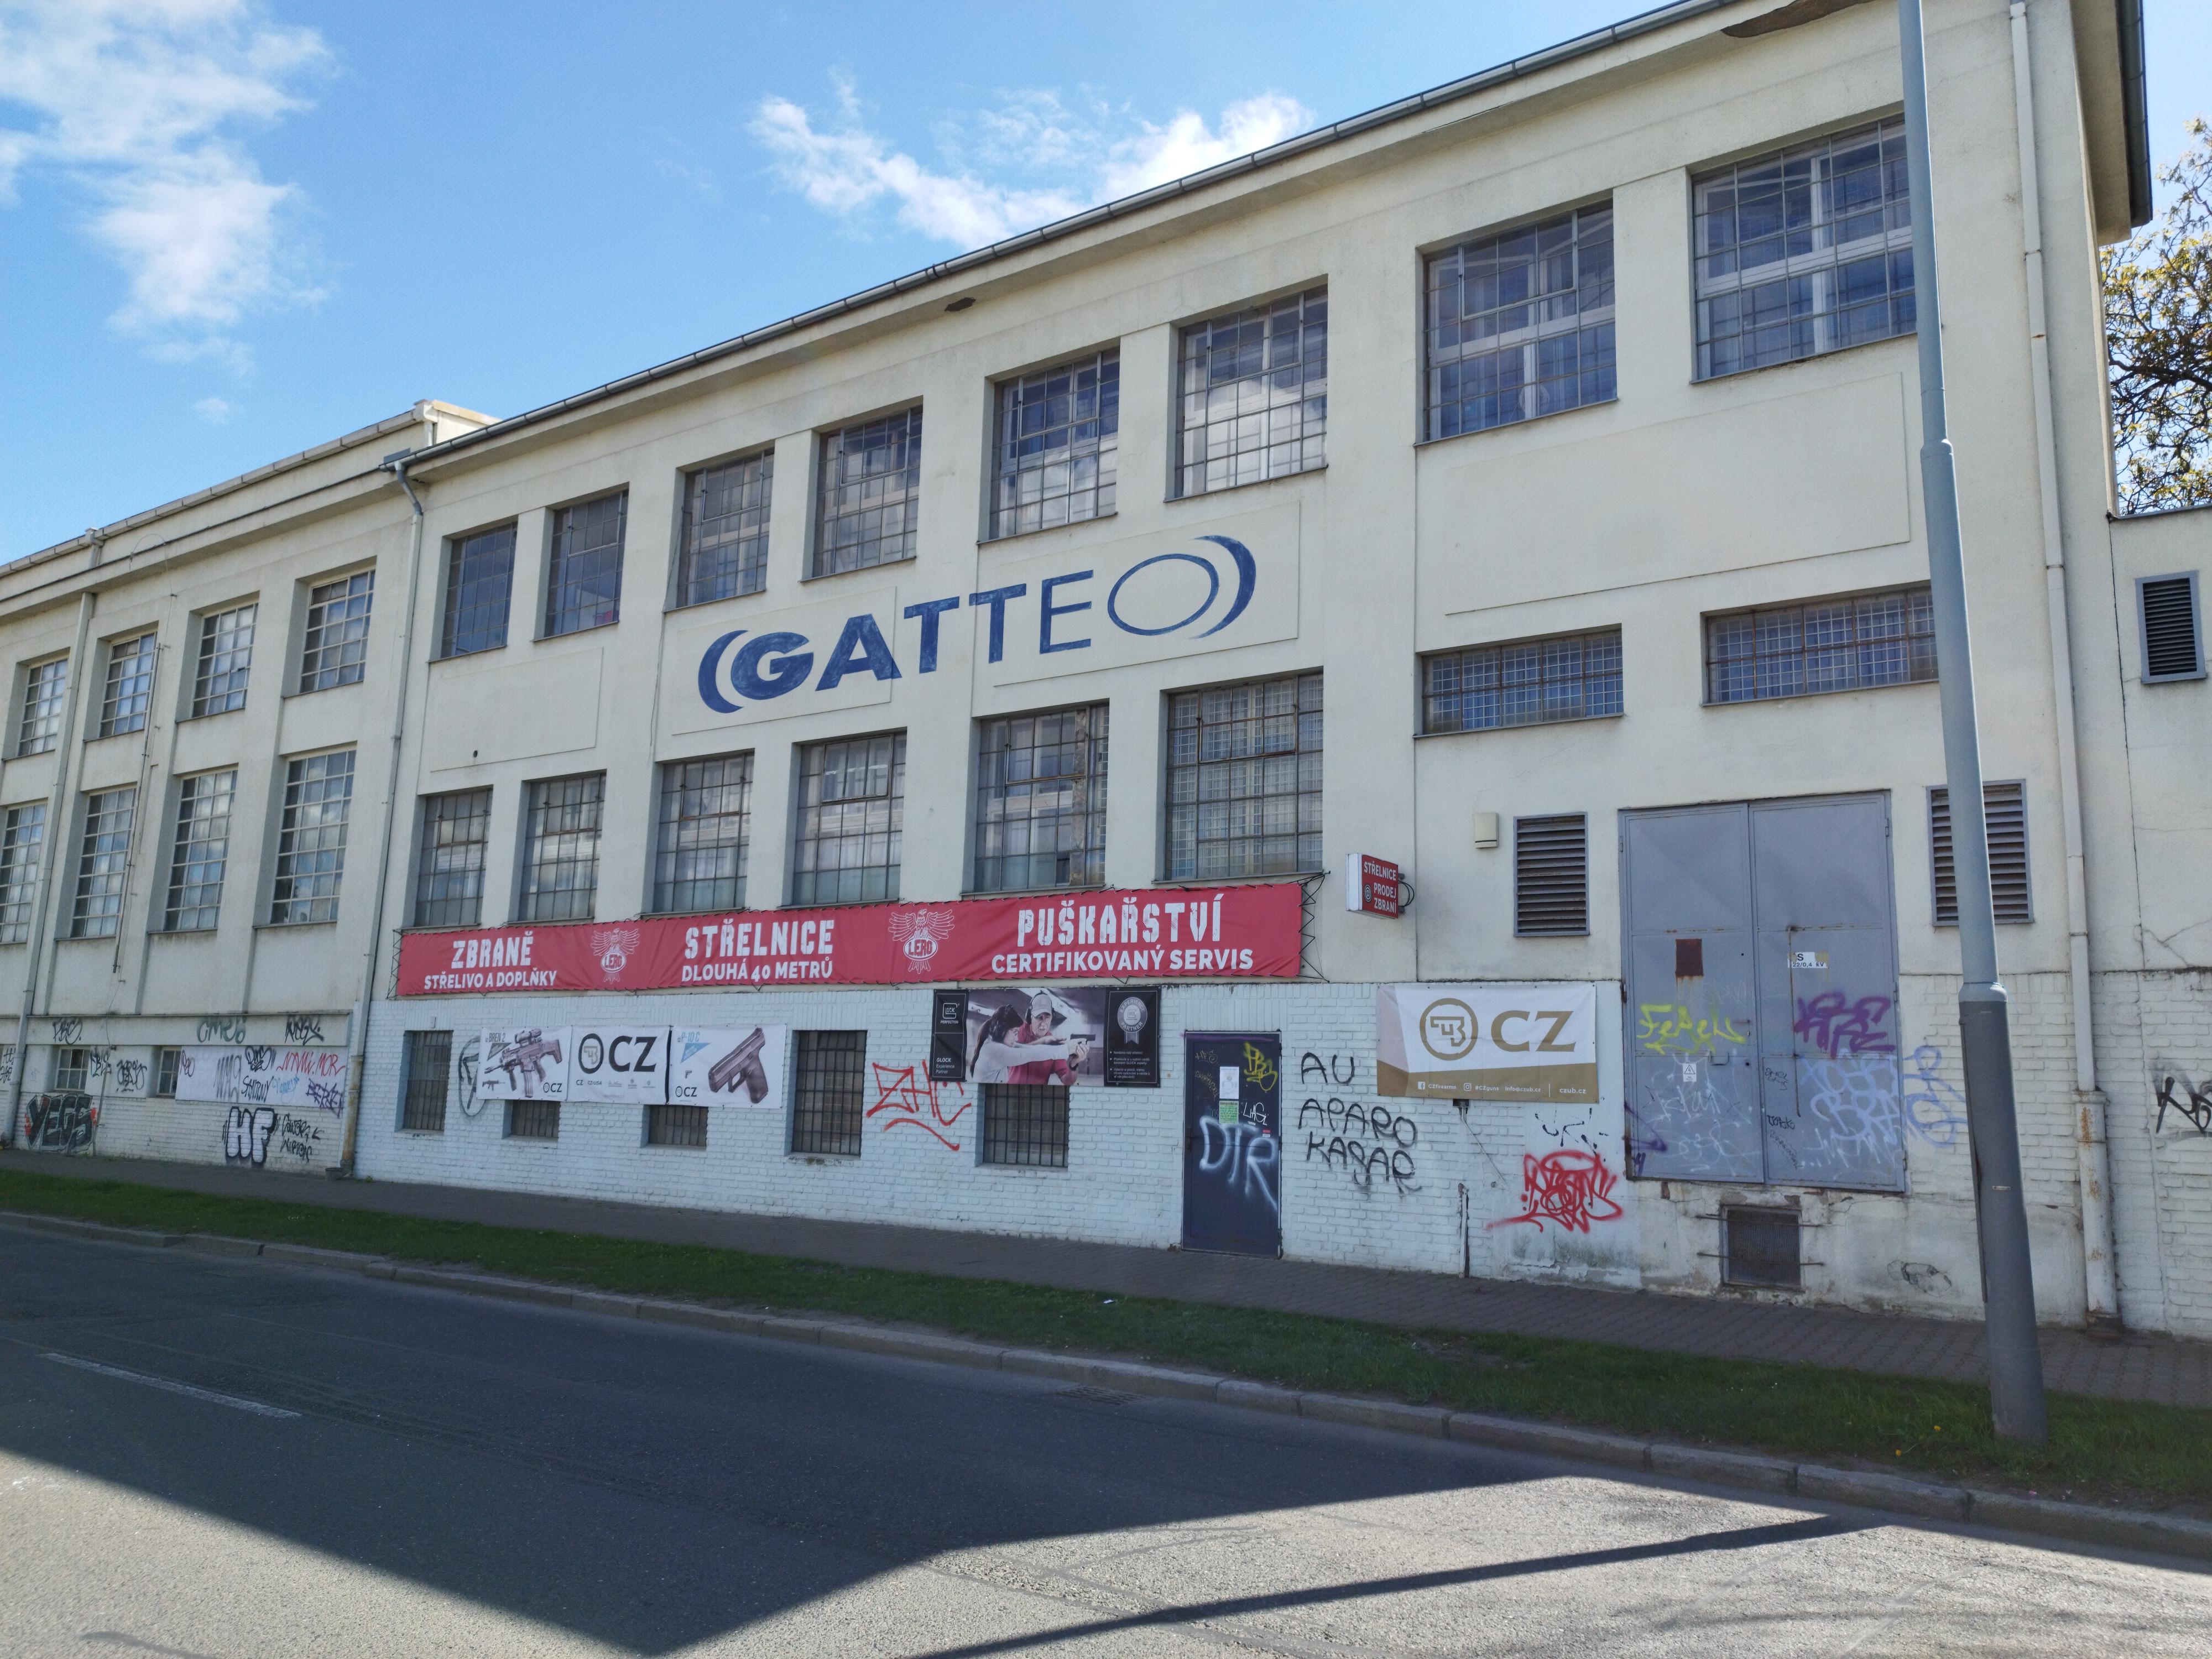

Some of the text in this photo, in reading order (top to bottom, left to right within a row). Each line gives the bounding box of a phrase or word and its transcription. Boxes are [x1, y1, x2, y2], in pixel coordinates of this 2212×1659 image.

[731, 553, 1219, 701] GATTEO
[1364, 861, 1396, 881] STŘELNICE
[1374, 882, 1396, 898] PRODEJ
[1374, 897, 1396, 914] ZBRANÍ
[1018, 893, 1224, 947] PUŠKAŘSTVÍ
[684, 918, 834, 959] STŘELNICE
[908, 939, 933, 957] LERO
[451, 931, 534, 969] ZBRANĚ
[992, 945, 1253, 973] CERTIFIKOVANÝ SERVIS
[424, 967, 557, 990] STŘELIVO A DOPLŇKY
[681, 956, 833, 982] DLOUHÁ 40 METRŮ
[1119, 998, 1146, 1013] EXPERIENCE
[1120, 1021, 1143, 1031] PARTNER
[1491, 1010, 1576, 1052] CZ
[489, 1032, 505, 1042] BREN 2
[609, 1035, 658, 1072] CZ
[550, 1083, 562, 1093] CZ
[684, 1087, 697, 1097] CZ
